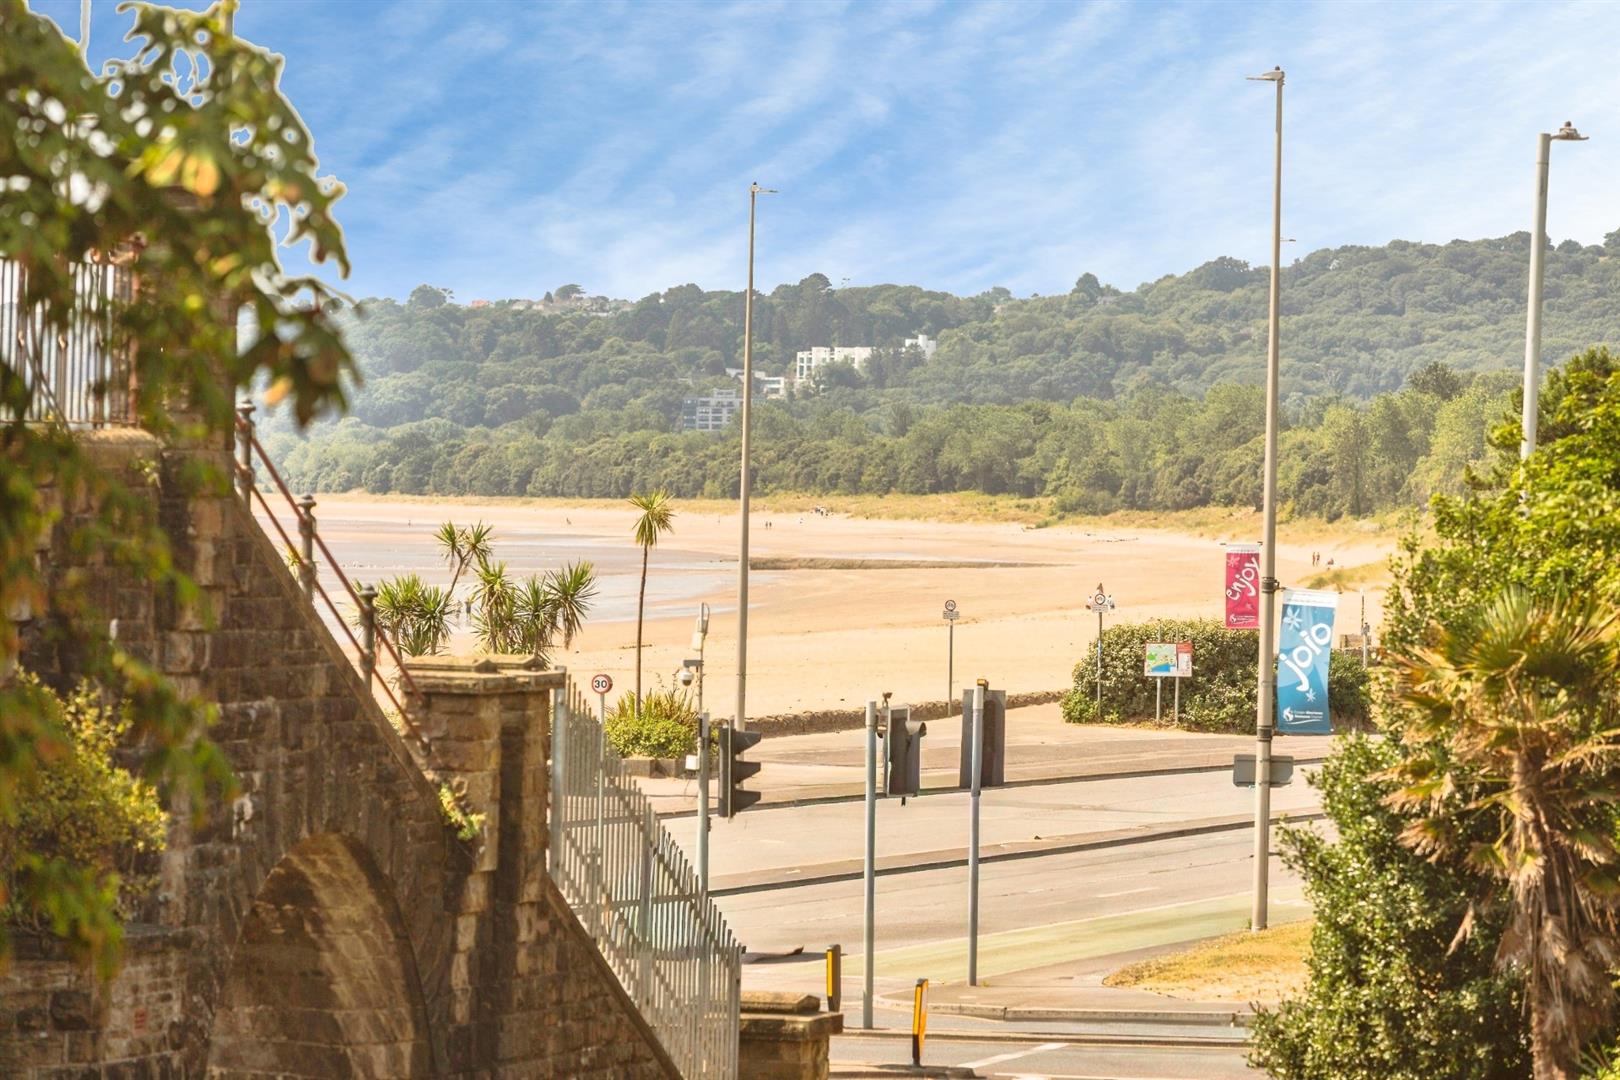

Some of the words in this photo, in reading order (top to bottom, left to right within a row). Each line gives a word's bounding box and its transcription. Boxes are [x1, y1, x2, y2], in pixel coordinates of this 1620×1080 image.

[1226, 557, 1260, 601] enjoy
[1279, 623, 1331, 692] joio
[594, 679, 607, 688] 30
